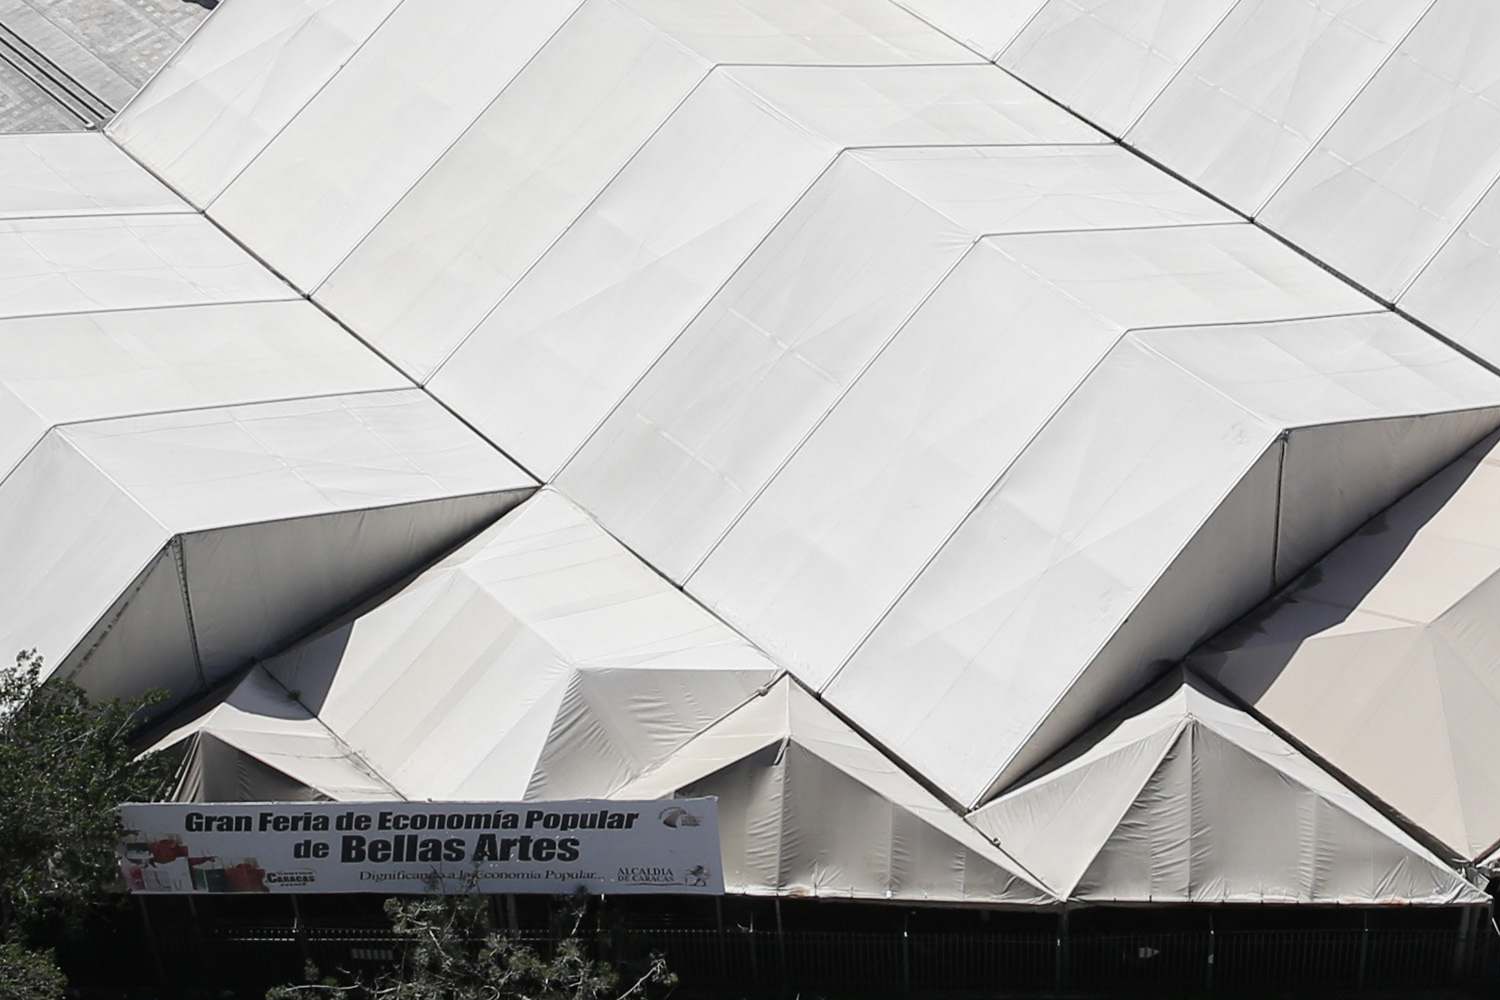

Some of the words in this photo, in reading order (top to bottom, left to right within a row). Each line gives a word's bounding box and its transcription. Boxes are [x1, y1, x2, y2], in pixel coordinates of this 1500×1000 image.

[185, 812, 252, 832] Gran
[259, 811, 329, 832] Feria
[336, 812, 371, 831] de
[378, 807, 518, 832] Economía
[524, 808, 641, 832] Popular
[294, 839, 330, 860] de
[341, 834, 465, 863] Bellas
[472, 833, 580, 861] Artes
